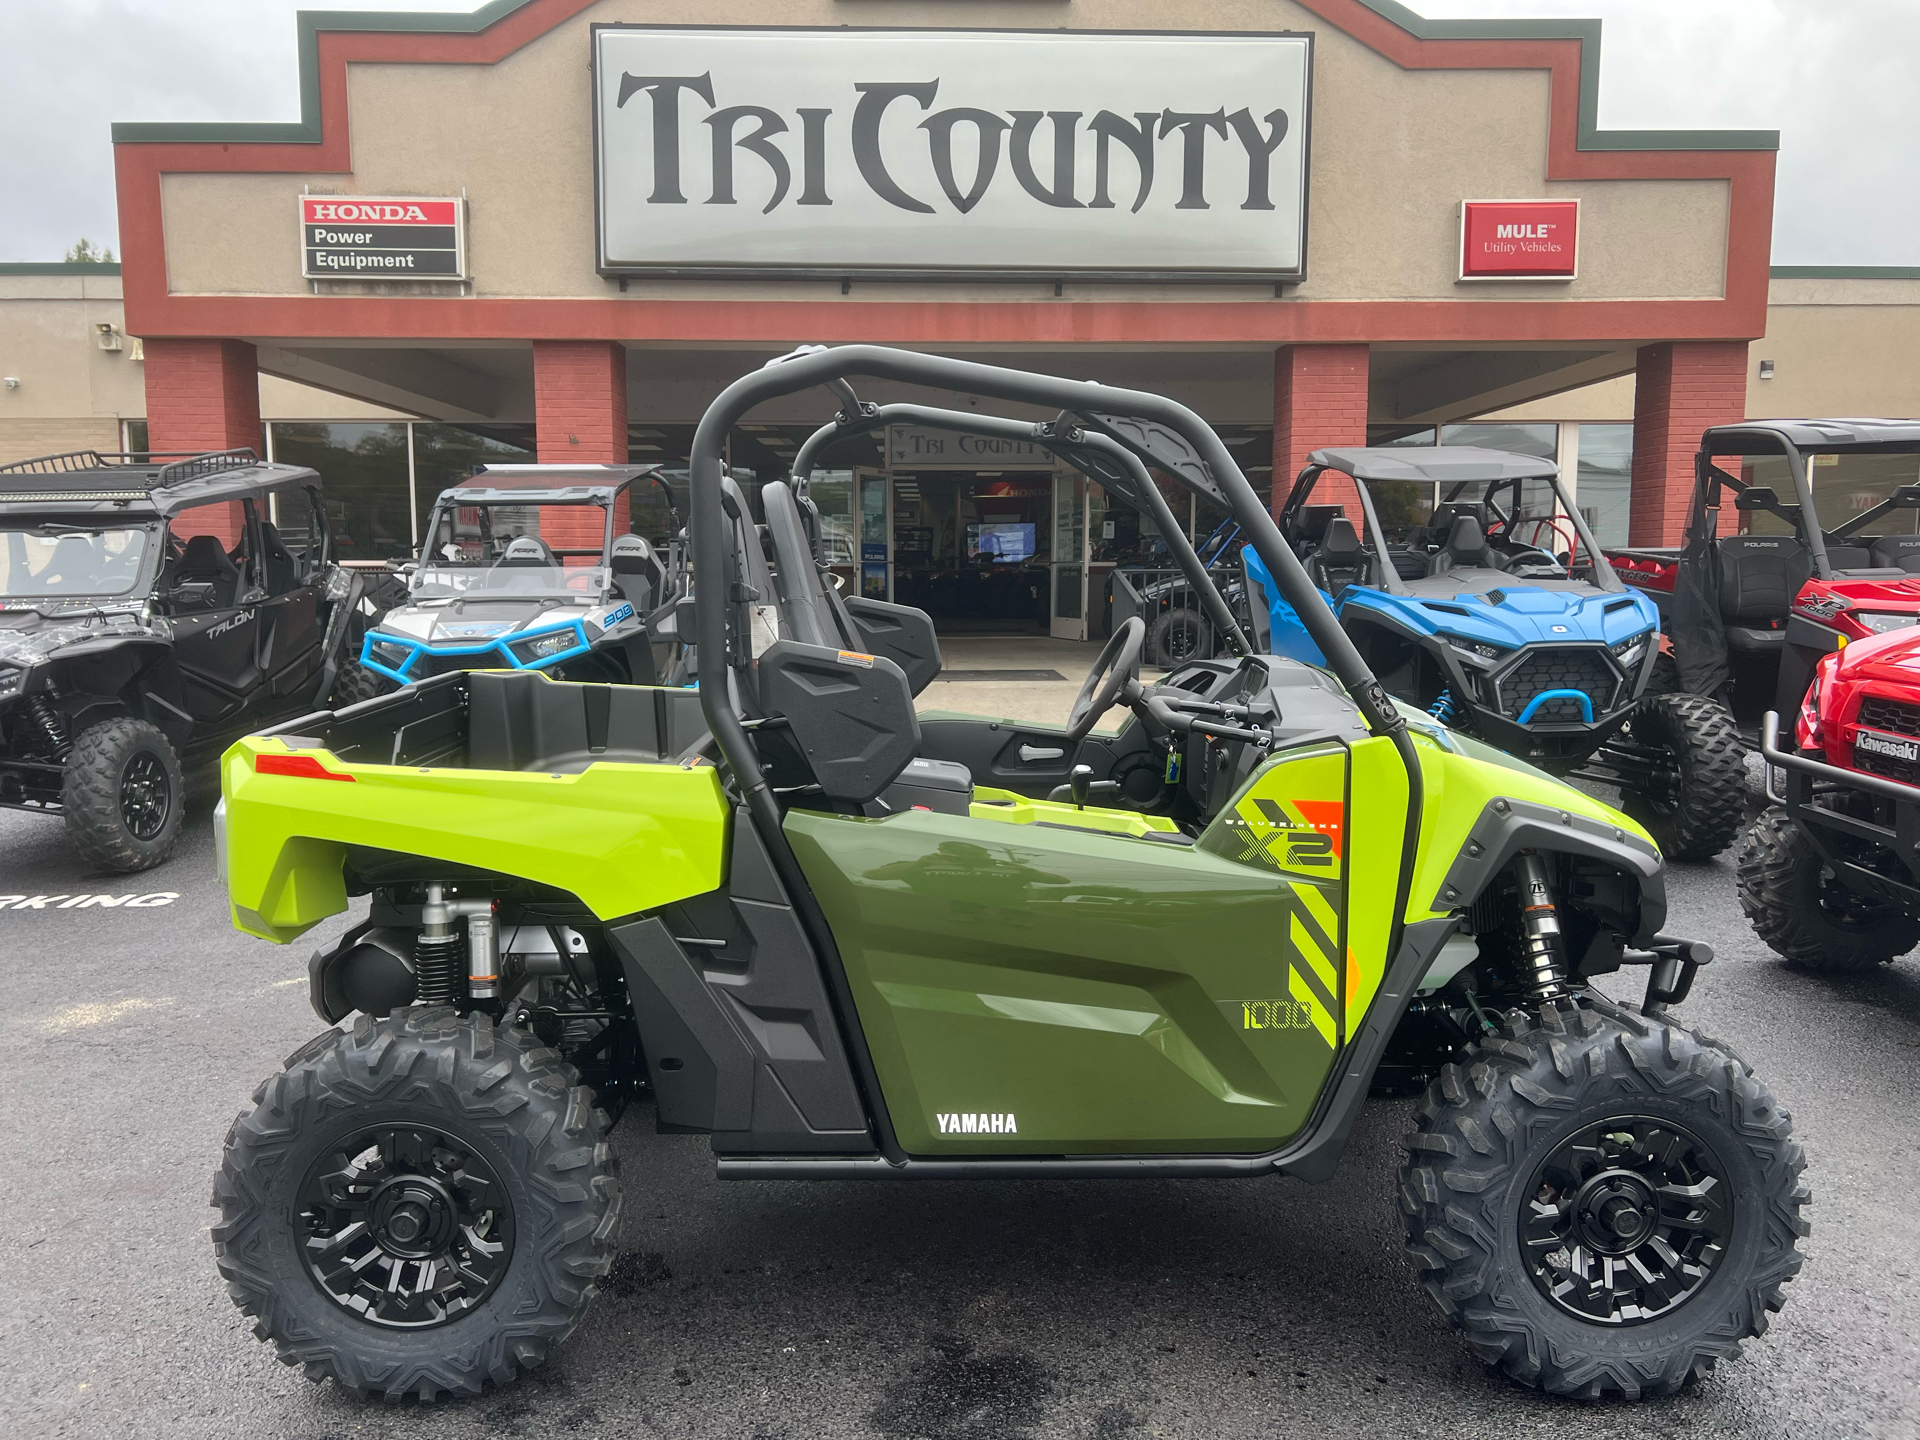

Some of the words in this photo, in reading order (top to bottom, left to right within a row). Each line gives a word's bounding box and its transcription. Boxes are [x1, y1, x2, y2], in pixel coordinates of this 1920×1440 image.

[313, 204, 428, 221] HONDA
[314, 228, 373, 244] Power
[1484, 241, 1517, 255] Utility
[1519, 241, 1562, 253] Vehicles
[315, 251, 415, 270] Equipment
[909, 434, 944, 454] TRI
[864, 553, 885, 561] POLARIS
[1799, 593, 1846, 611] XP
[1803, 603, 1836, 619] 1000
[206, 608, 256, 640] TALON
[603, 602, 635, 629] 900
[1855, 731, 1919, 761] Kawasaki
[1231, 829, 1334, 867] X2
[1241, 1000, 1312, 1030] 1000
[936, 1112, 1018, 1134] YAMAHA
